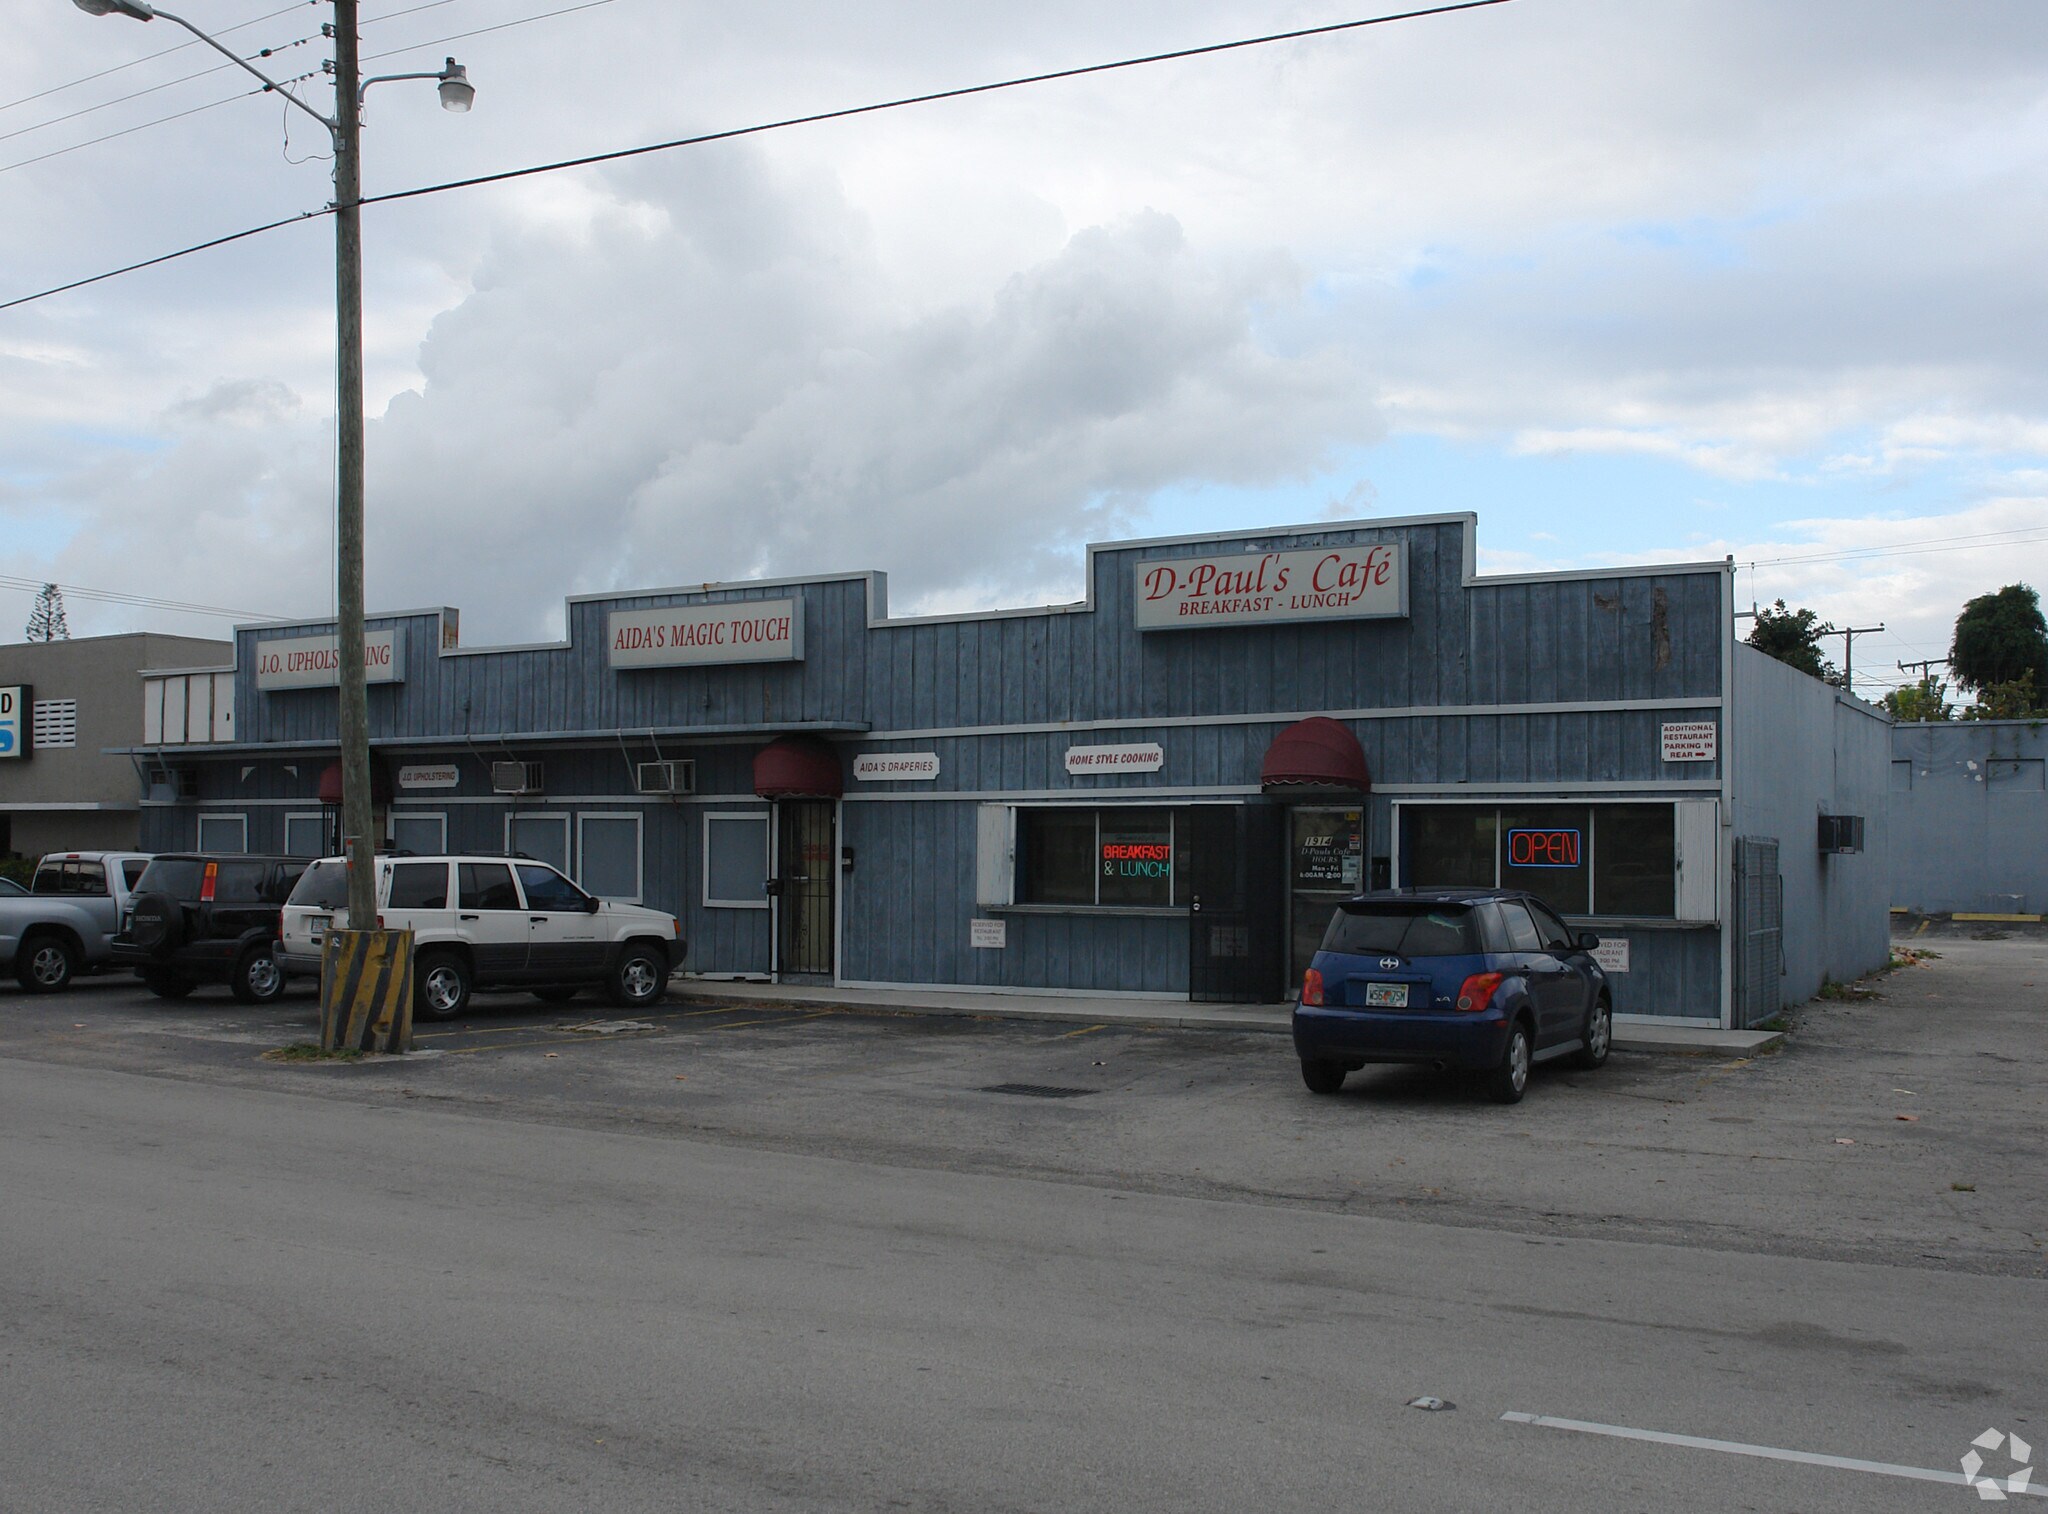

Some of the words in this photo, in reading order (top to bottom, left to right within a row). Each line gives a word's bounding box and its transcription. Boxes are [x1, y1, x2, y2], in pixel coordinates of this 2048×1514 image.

[1145, 554, 1291, 601] D-Paul's
[1312, 546, 1392, 601] Café
[1179, 596, 1274, 616] BREAKFAST
[1290, 592, 1350, 610] LUNCH
[614, 625, 665, 650] AIDA'S
[670, 622, 725, 647] MAGIC
[731, 617, 790, 643] TOUCH
[259, 654, 282, 674] J.O.
[288, 645, 390, 672] UPHOLSING
[859, 762, 886, 772] AIDA'S
[887, 761, 934, 772] DRAPERIES
[1069, 755, 1094, 765] HOME
[1095, 754, 1119, 764] STYLE
[1120, 752, 1159, 763] COOKING
[413, 771, 456, 781] UPHOLSTERING
[1305, 837, 1332, 846] 1914
[1512, 832, 1577, 863] OPEN
[1103, 845, 1170, 860] BREAKFAST
[1104, 860, 1115, 876] &
[1120, 861, 1170, 878] LUNCH
